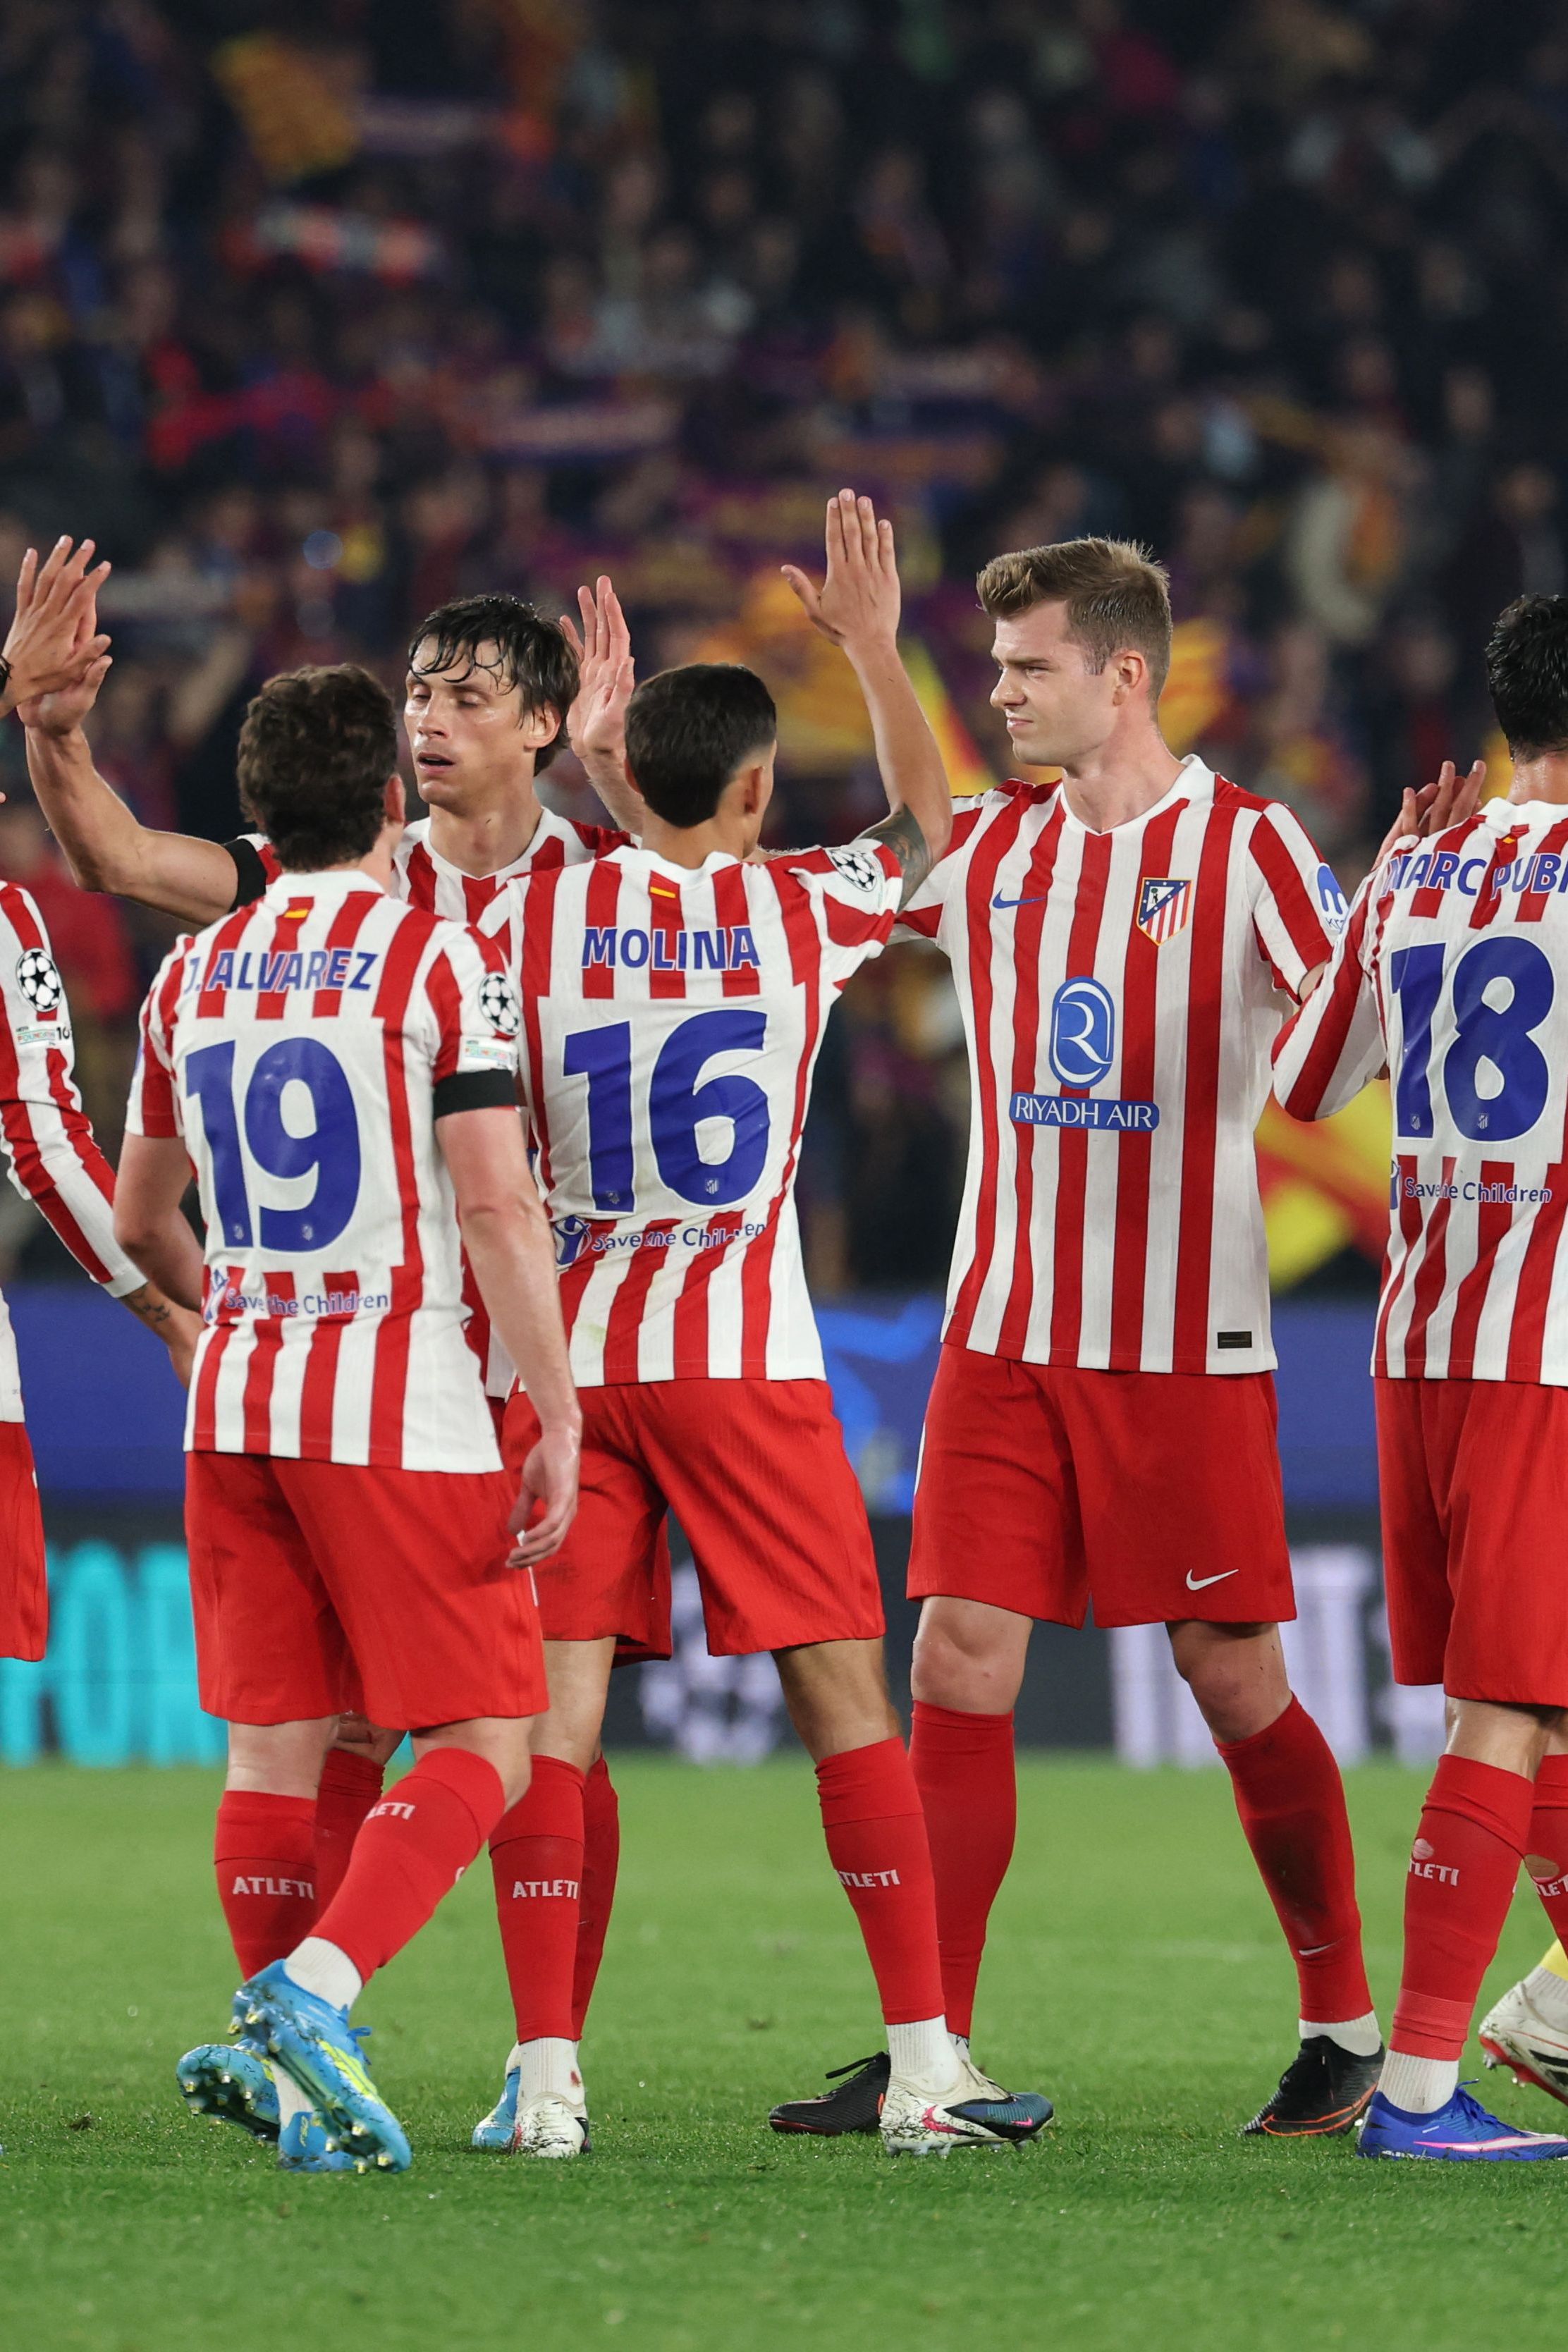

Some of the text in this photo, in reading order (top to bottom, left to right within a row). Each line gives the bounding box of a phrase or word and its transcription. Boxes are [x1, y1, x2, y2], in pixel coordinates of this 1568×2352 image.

[582, 927, 761, 970] MOLINA
[183, 950, 379, 994] J. ALVAREZ
[1391, 936, 1555, 1142] 18
[563, 1009, 770, 1213] 16
[1015, 1096, 1153, 1128] RIYADH AIR
[185, 1036, 362, 1254] 19
[1463, 1182, 1551, 1203] Children
[592, 1233, 641, 1251] Save
[682, 1223, 767, 1249] Chilen
[226, 1289, 265, 1311] Save
[304, 1294, 388, 1316] Children
[232, 1876, 314, 1899] ATLETI
[513, 1880, 579, 1899] ATLETI
